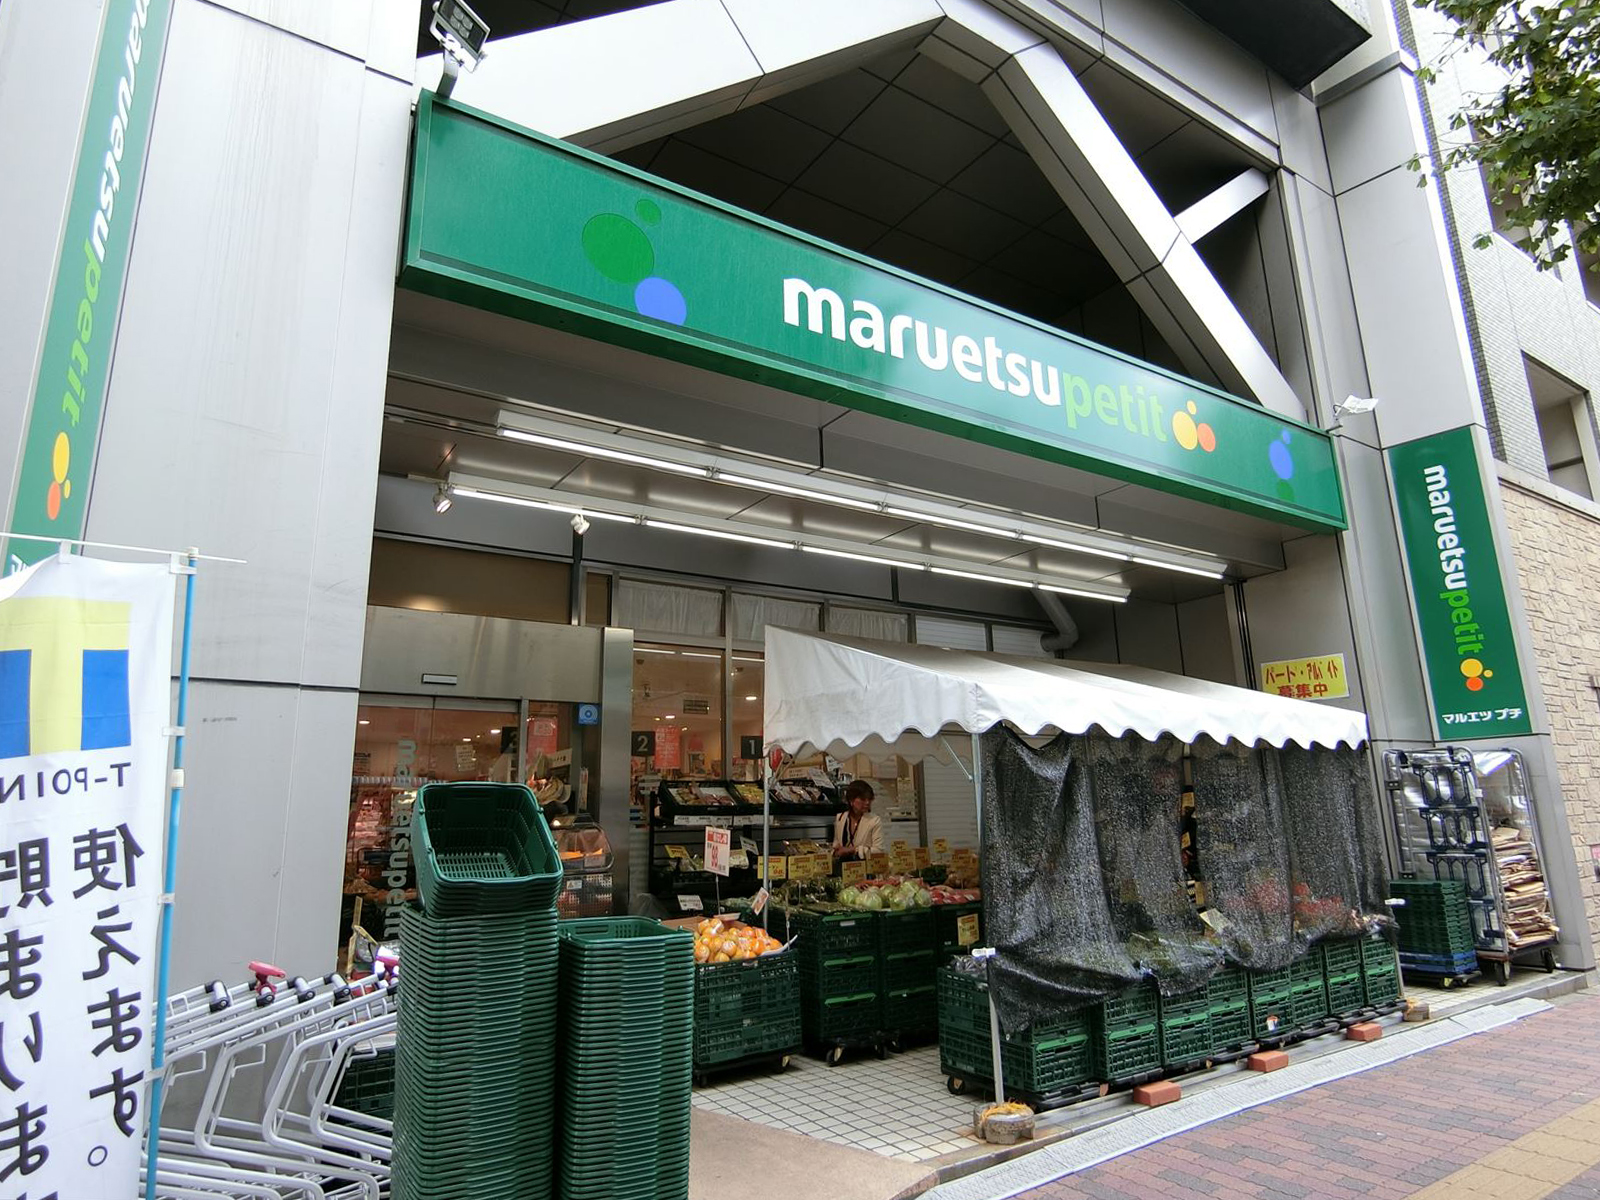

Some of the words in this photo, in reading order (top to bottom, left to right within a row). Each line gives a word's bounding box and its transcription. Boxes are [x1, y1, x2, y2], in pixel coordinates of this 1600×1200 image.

[1441, 710, 1492, 724] マルエツ
[1495, 708, 1522, 720] プチ
[637, 735, 648, 752] 2
[749, 739, 756, 755] 1
